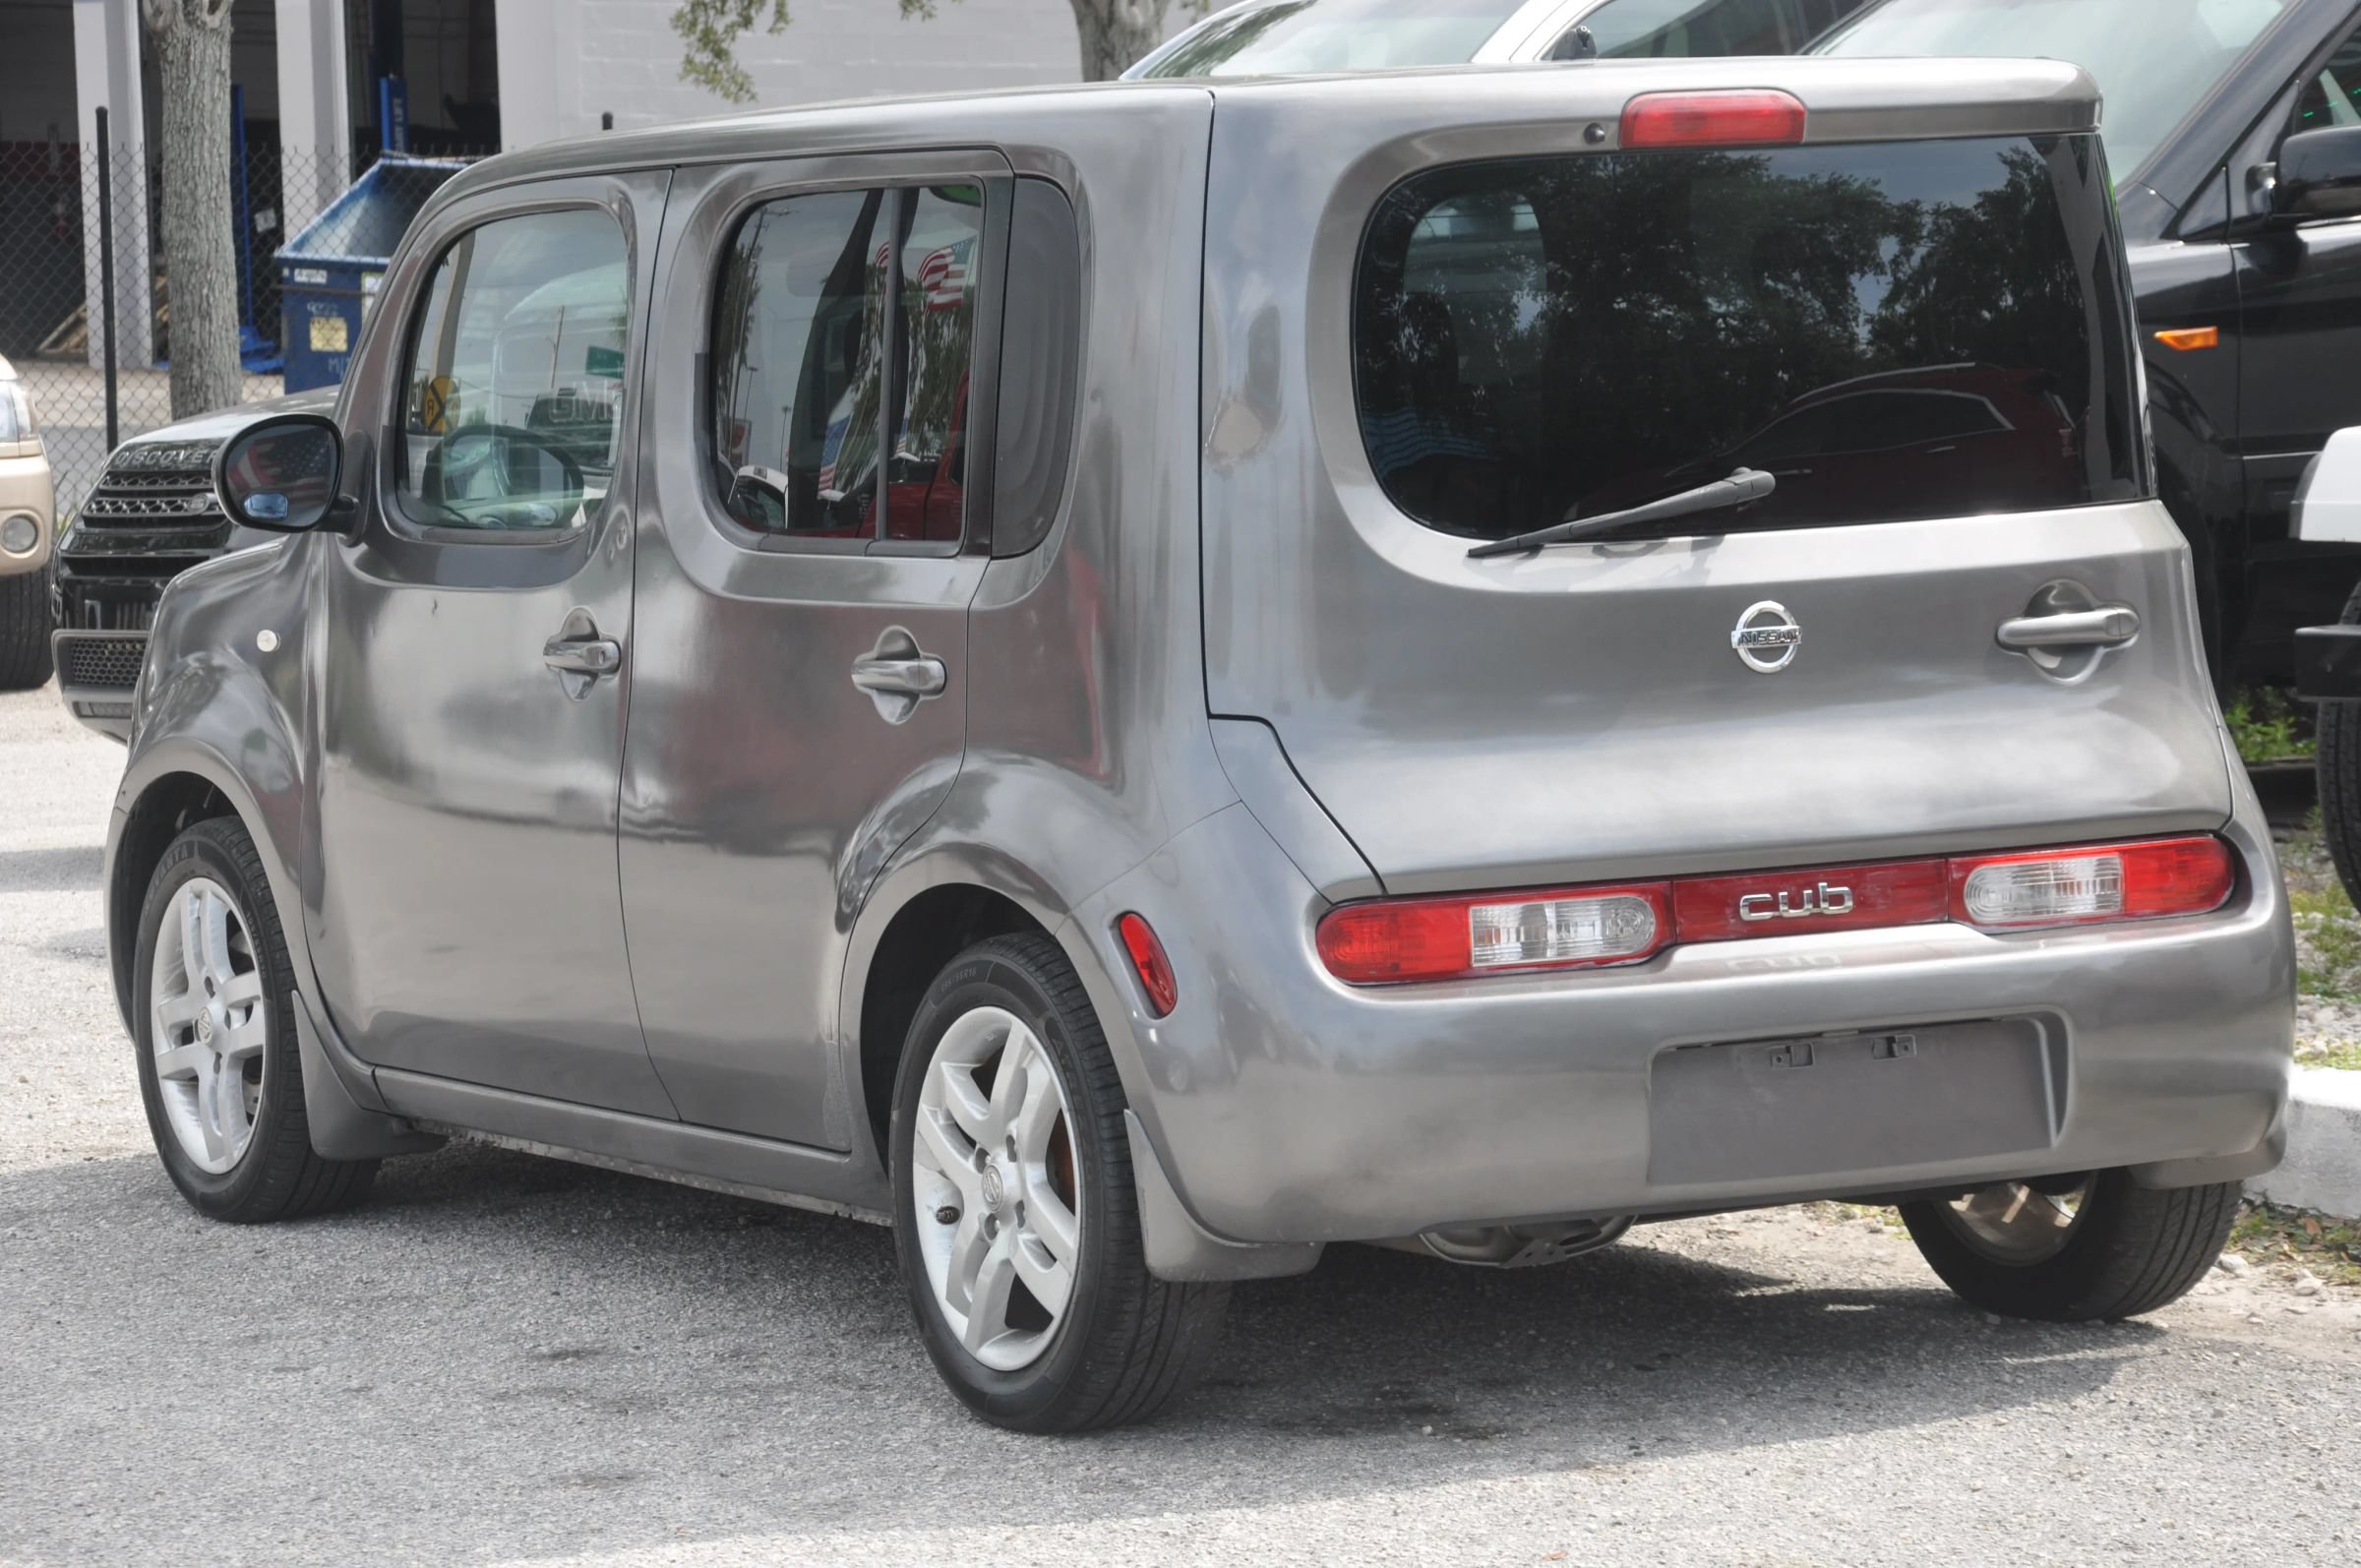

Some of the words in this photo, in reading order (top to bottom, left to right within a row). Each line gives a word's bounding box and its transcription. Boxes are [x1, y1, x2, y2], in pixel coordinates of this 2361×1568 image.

[113, 447, 216, 464] DISCOVER
[1737, 629, 1799, 646] NISSAN
[1739, 882, 1853, 921] cub
